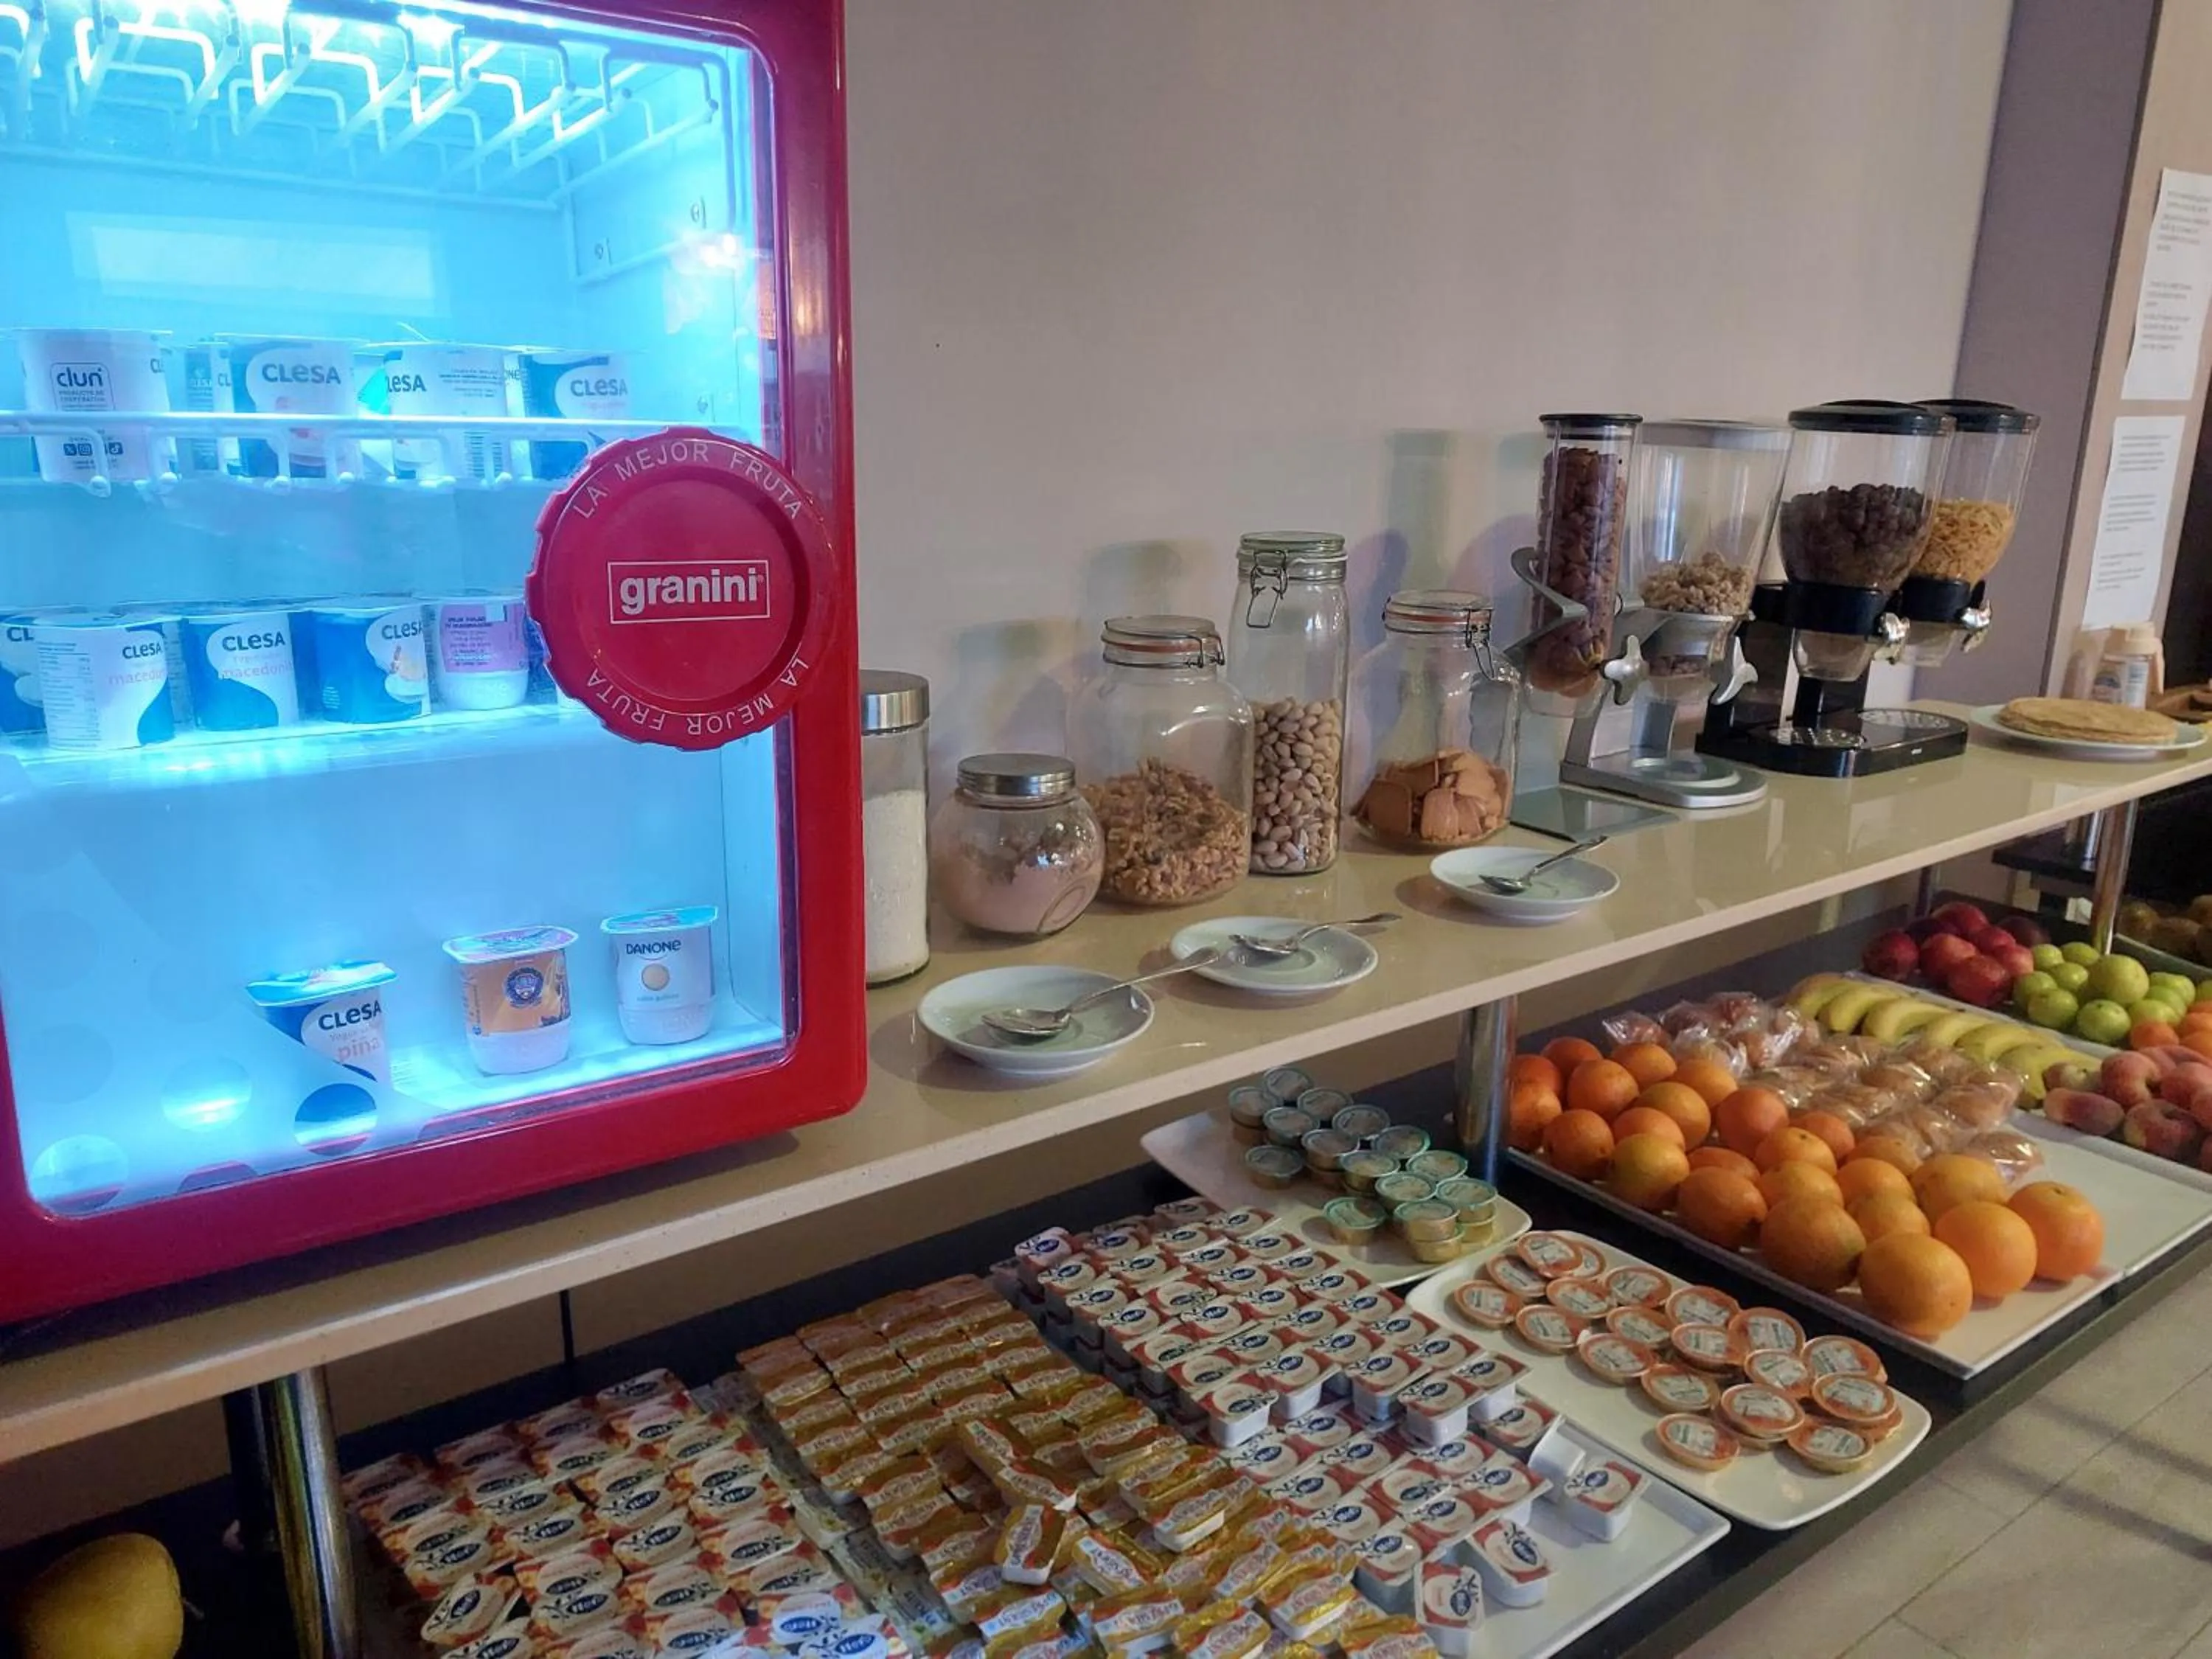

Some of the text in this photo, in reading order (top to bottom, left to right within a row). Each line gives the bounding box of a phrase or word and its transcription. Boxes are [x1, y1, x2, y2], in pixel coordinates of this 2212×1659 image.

[57, 366, 103, 387] clun
[573, 442, 802, 519] LA MEJOR FRUTA
[620, 567, 757, 616] granini
[586, 657, 809, 735] LA MEJOR FRUTA
